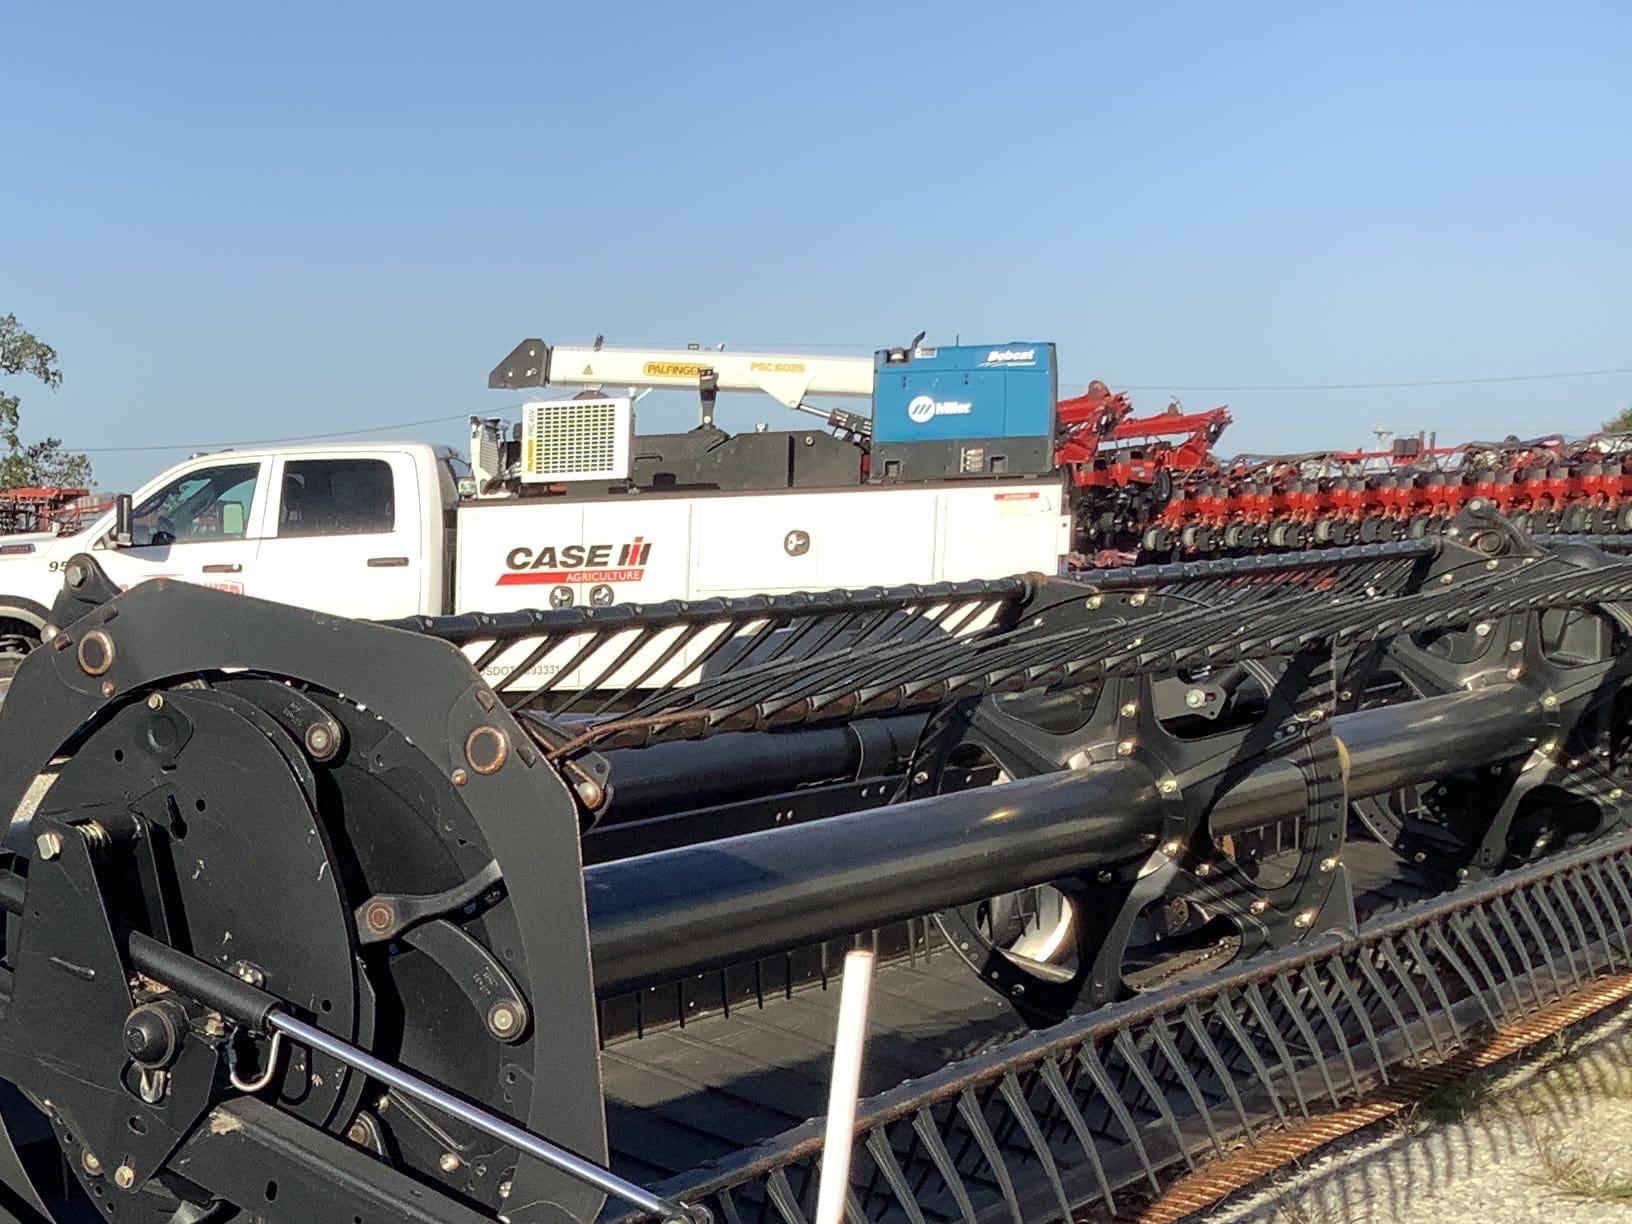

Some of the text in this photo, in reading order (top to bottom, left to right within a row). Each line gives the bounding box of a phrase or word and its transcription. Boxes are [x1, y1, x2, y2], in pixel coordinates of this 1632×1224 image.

[987, 349, 1035, 362] Bobcat
[935, 401, 971, 416] Miller
[505, 545, 613, 571] CASE
[566, 571, 641, 583] AGRICULTURE
